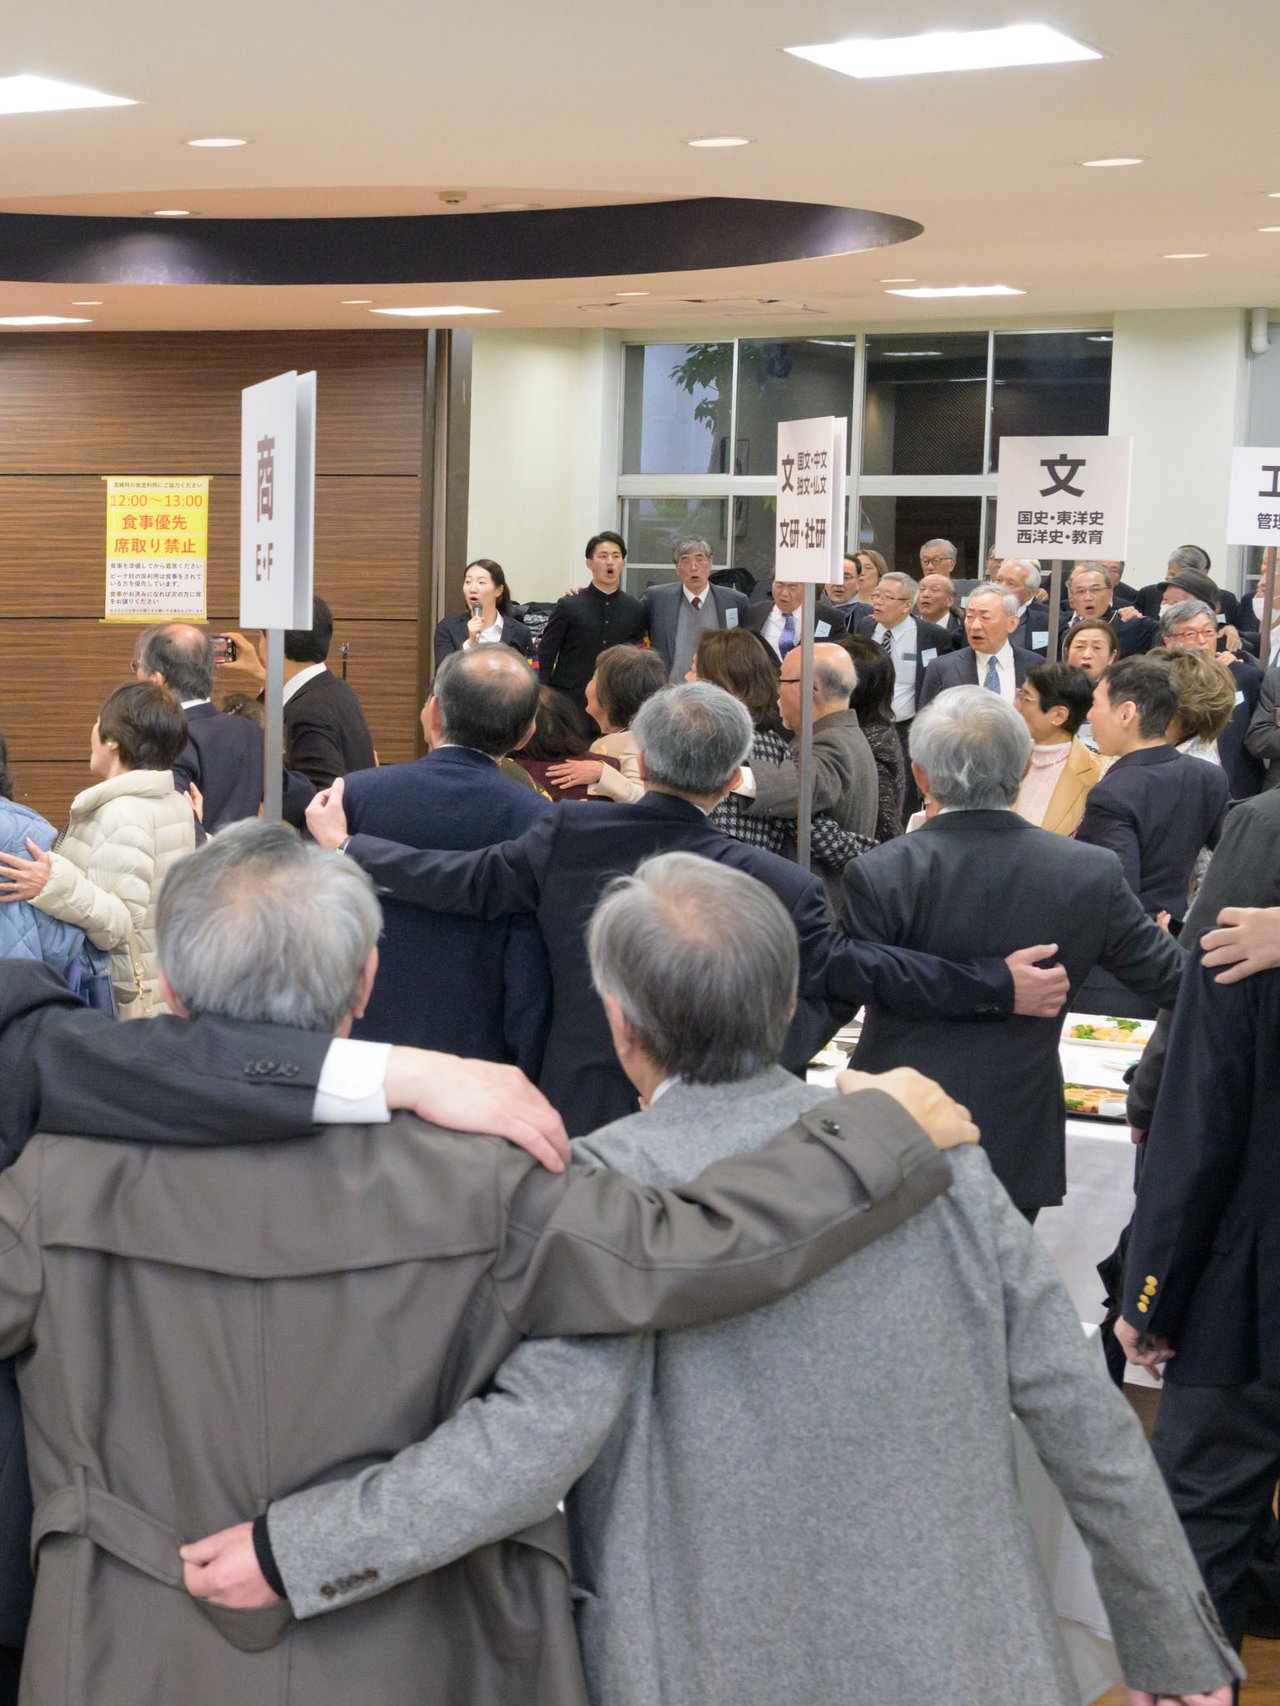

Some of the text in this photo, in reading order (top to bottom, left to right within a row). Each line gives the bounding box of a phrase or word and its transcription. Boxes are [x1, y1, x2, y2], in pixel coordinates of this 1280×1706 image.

[256, 434, 275, 523] 商
[781, 453, 795, 493] 文
[1039, 453, 1087, 498] 文
[121, 513, 188, 530] 食事優先
[1017, 510, 1104, 526] 国史・東洋史
[113, 537, 197, 554] 席取り禁止
[1016, 529, 1103, 545] 西洋史・教育
